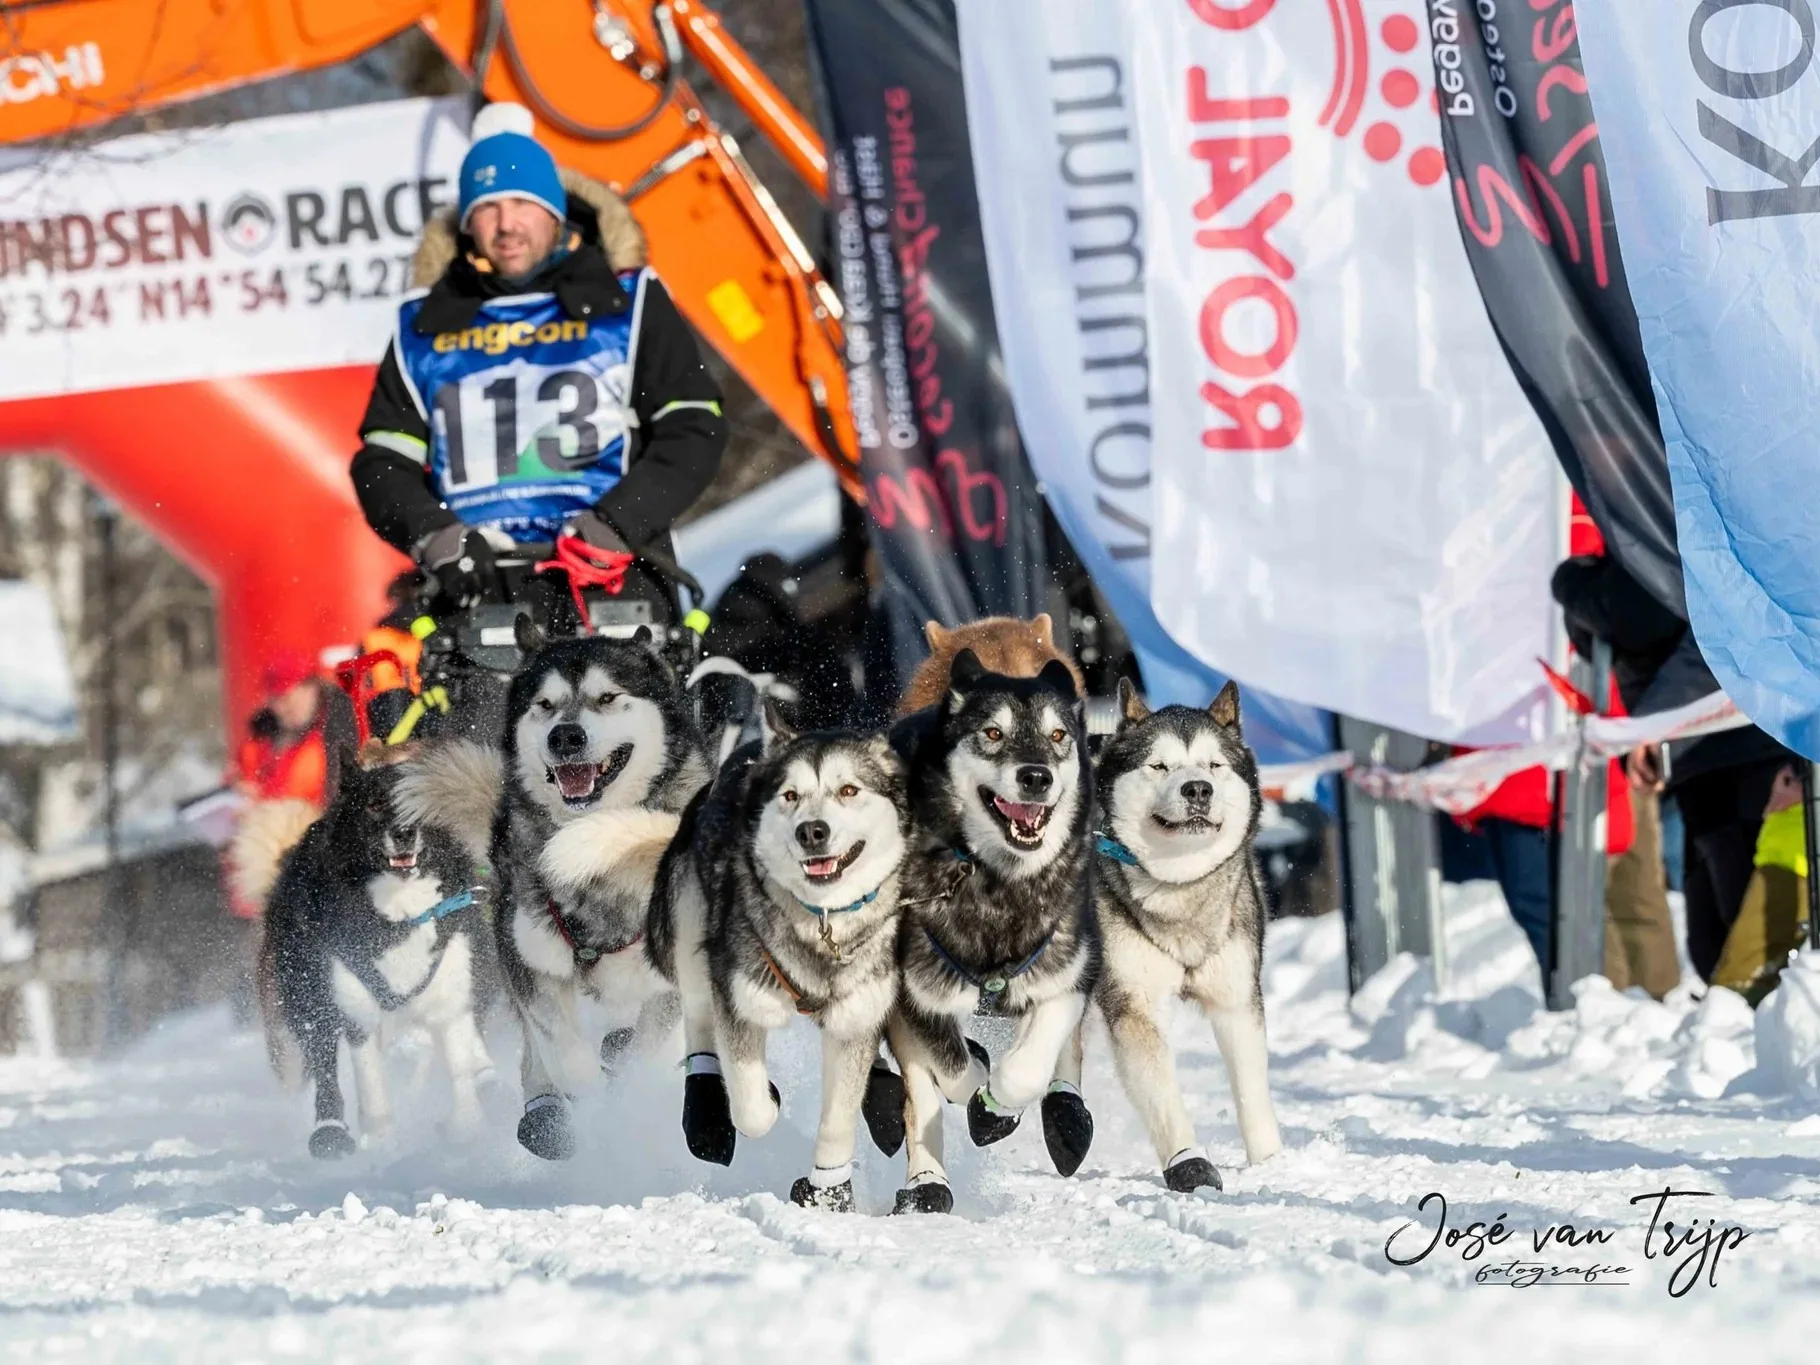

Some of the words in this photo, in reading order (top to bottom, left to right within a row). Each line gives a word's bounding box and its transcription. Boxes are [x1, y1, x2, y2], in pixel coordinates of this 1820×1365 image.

[0, 41, 105, 107] CHI
[0, 201, 211, 279] NDSEN
[433, 320, 589, 355] engcon
[433, 370, 600, 485] 113
